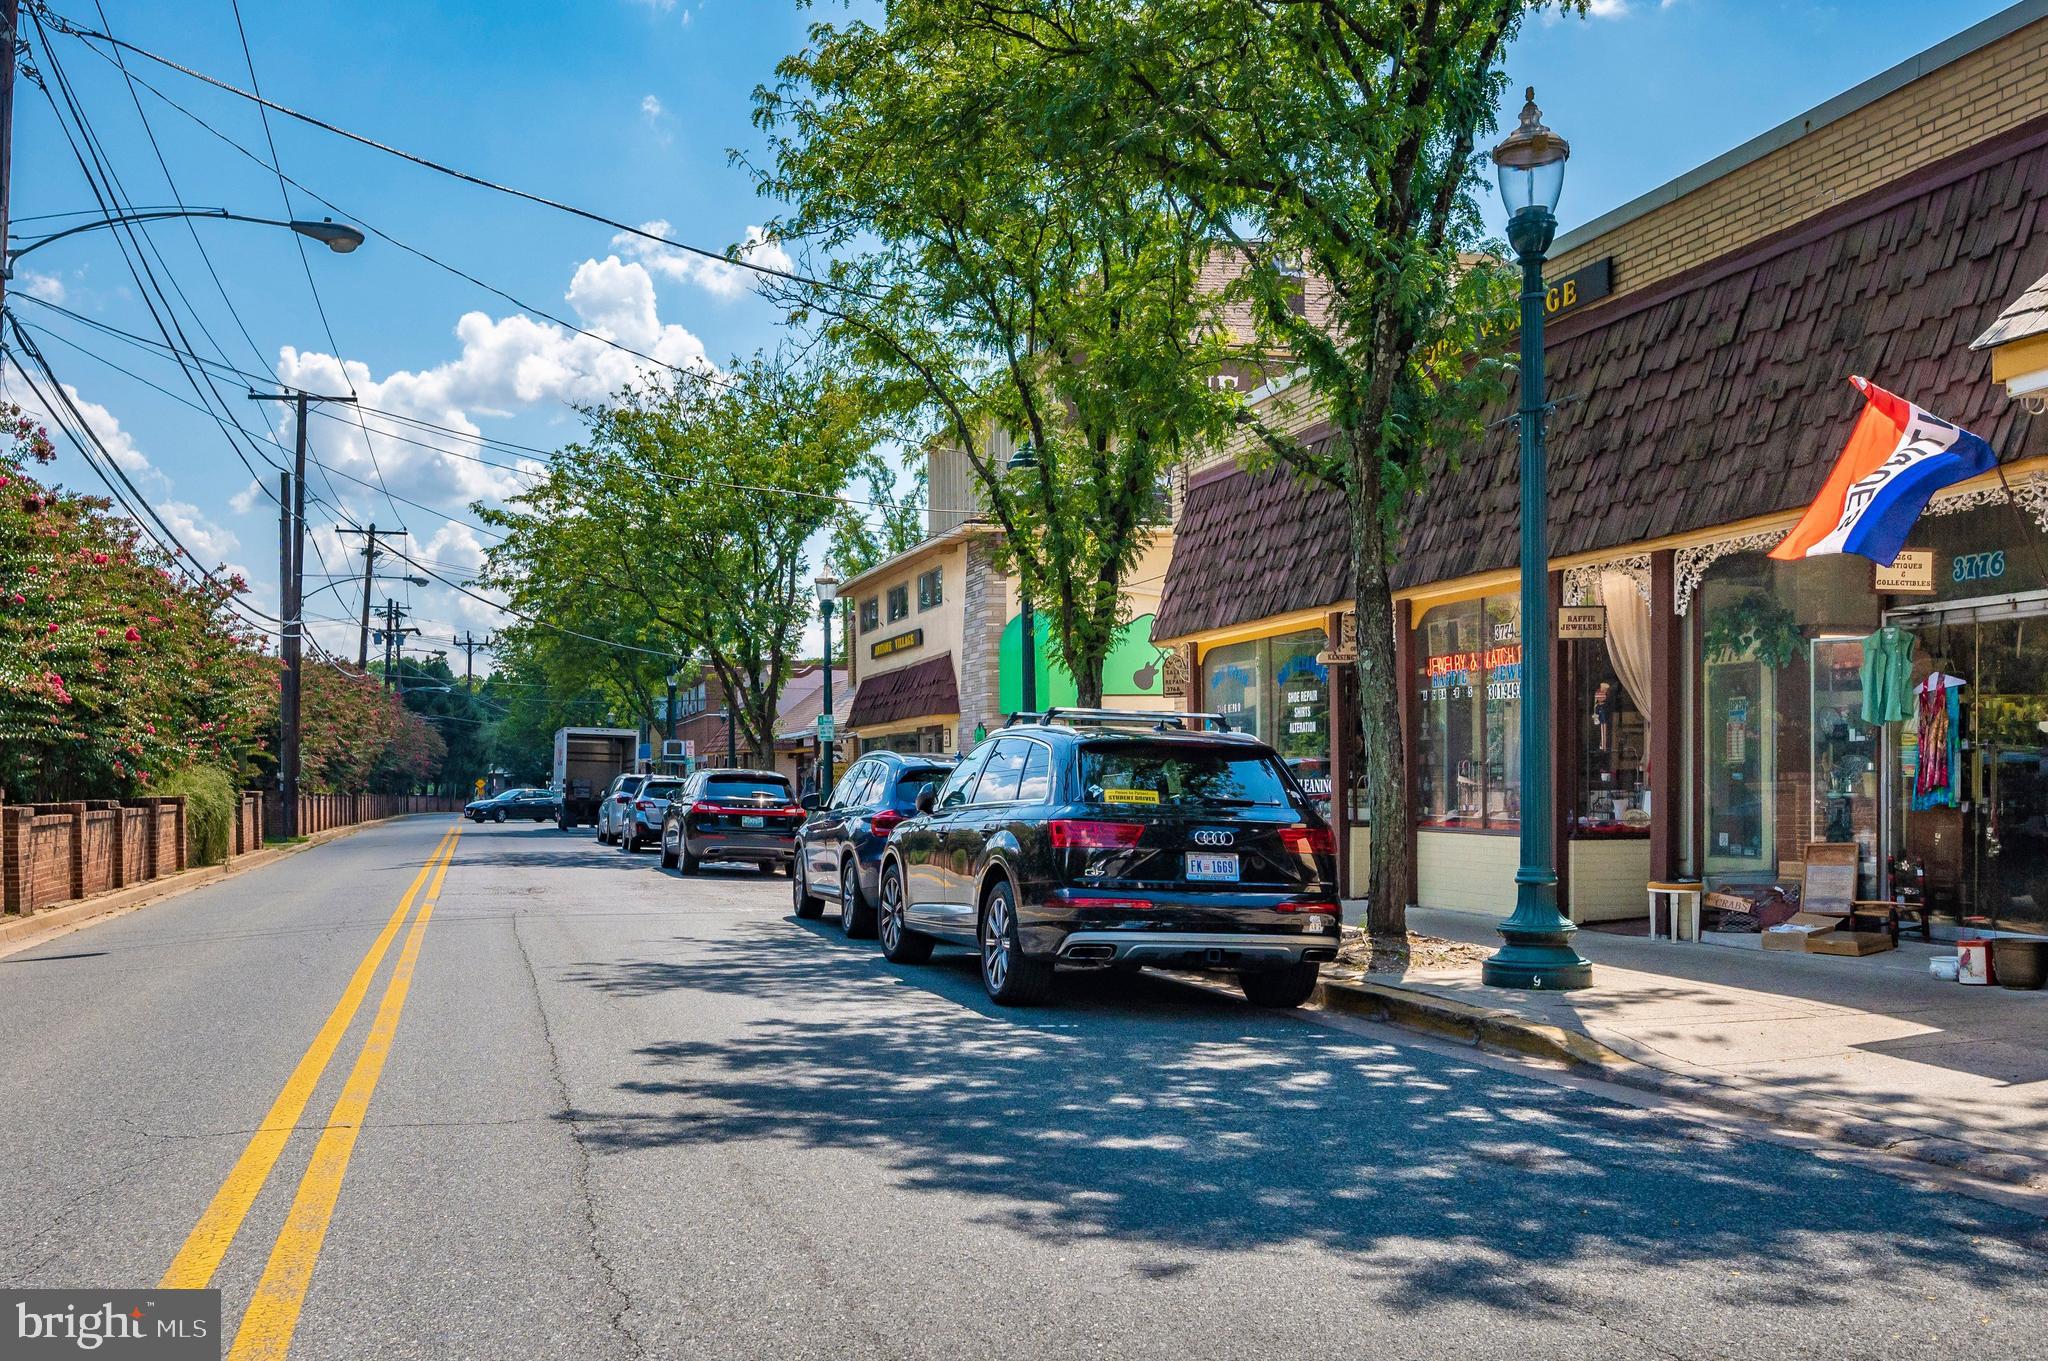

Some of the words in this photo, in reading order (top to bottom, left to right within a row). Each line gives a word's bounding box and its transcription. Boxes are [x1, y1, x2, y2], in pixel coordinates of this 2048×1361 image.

[1952, 550, 2006, 582] 3776
[1876, 579, 1931, 587] COLLECTIBLES
[1567, 615, 1596, 623] RAFFIE
[1560, 623, 1602, 631] JEWELERS
[1426, 654, 1466, 677] JEWELRY
[1432, 669, 1468, 689] RAFFIE
[1287, 691, 1300, 703] SHOE
[1301, 690, 1318, 702] REPAIR
[1294, 706, 1311, 718] SHIRTS
[1289, 721, 1317, 733] ALTERATION
[1190, 860, 1203, 872] FK
[1211, 860, 1234, 873] 1669
[1714, 898, 1749, 911] CRABS
